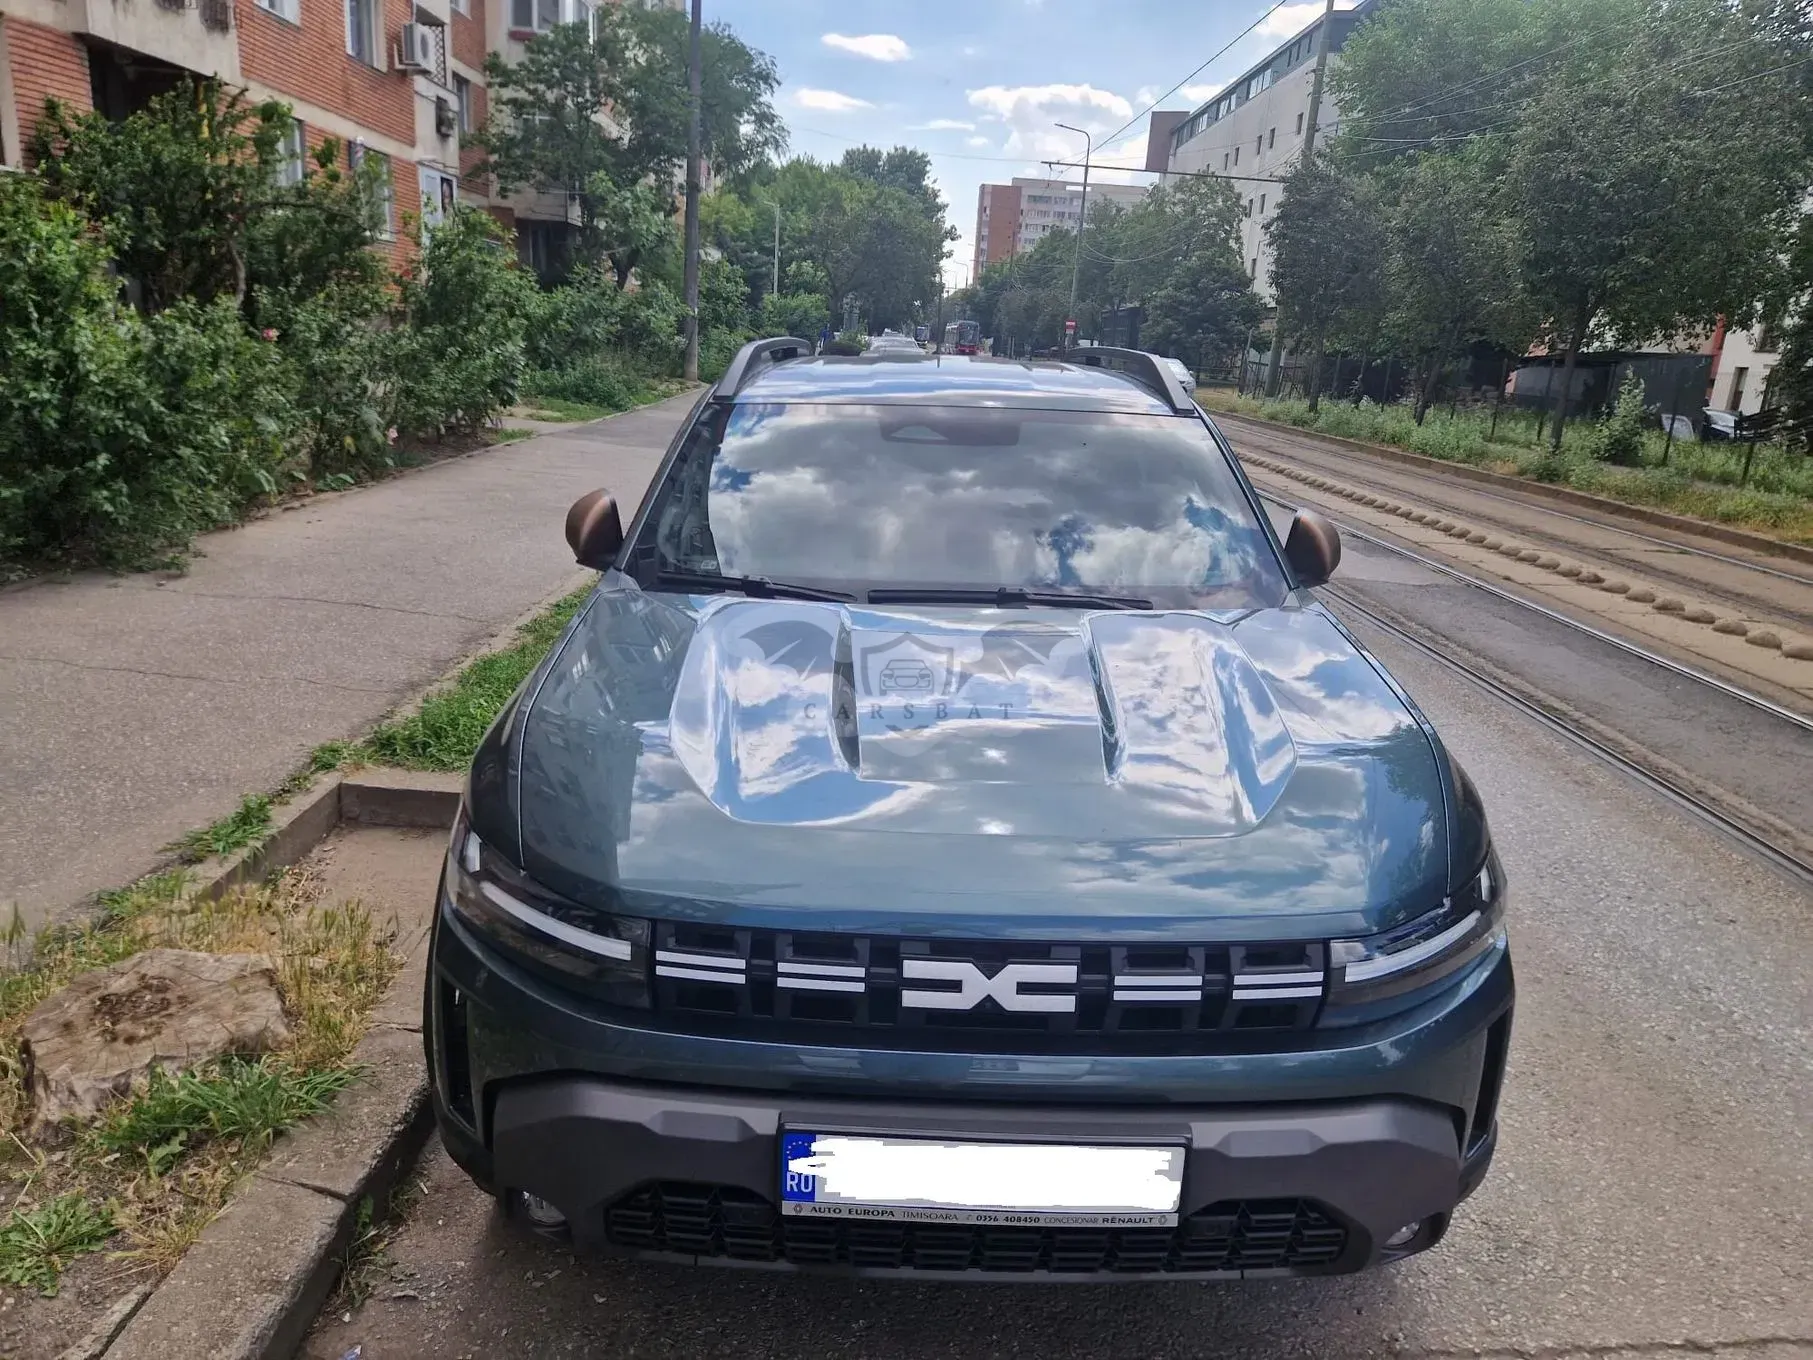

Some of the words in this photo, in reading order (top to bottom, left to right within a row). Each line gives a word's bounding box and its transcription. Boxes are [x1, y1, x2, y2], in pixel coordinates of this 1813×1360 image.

[786, 1171, 813, 1193] RO
[810, 1206, 842, 1215] AUTO
[849, 1207, 895, 1217] EUROPA
[902, 1211, 959, 1221] TIMISOARA
[976, 1214, 999, 1222] 0356
[1003, 1216, 1041, 1224] 408450
[1102, 1217, 1154, 1225] RENAULT
